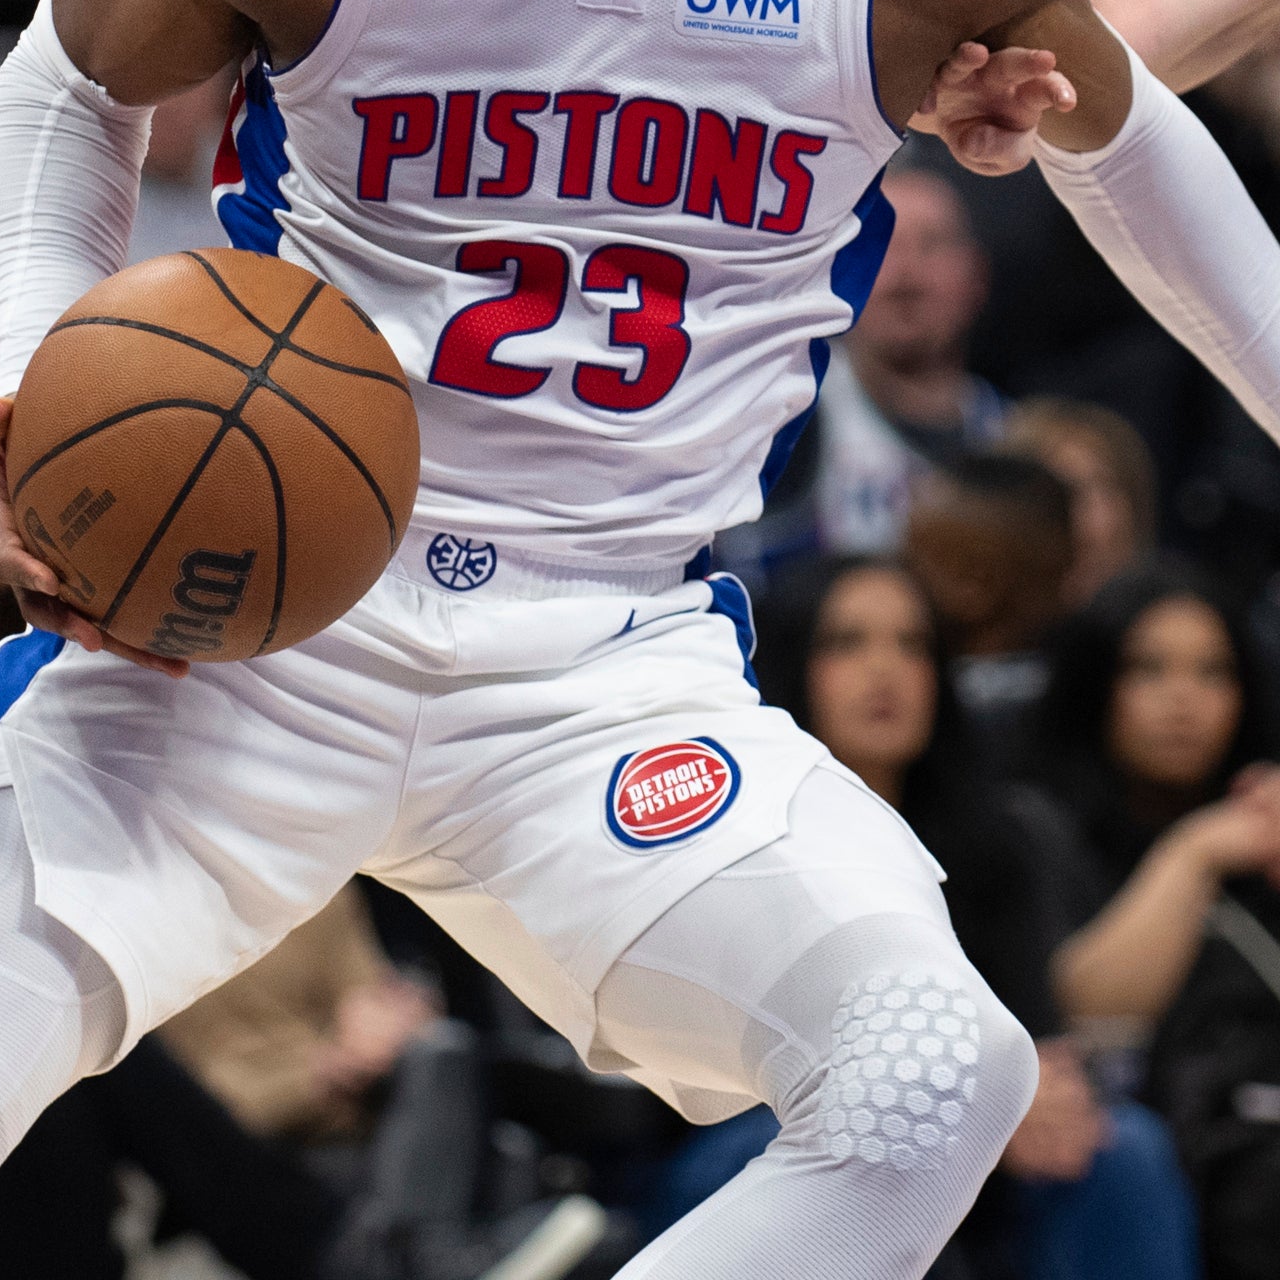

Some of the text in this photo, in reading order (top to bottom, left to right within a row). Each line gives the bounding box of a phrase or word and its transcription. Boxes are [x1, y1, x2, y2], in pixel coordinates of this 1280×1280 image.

[683, 19, 798, 39] UNITED WHOLESALE MORTGAGE
[352, 90, 828, 235] PISTONS
[428, 239, 692, 413] 23
[626, 758, 709, 804] DETROIT
[631, 773, 716, 821] PISTONS
